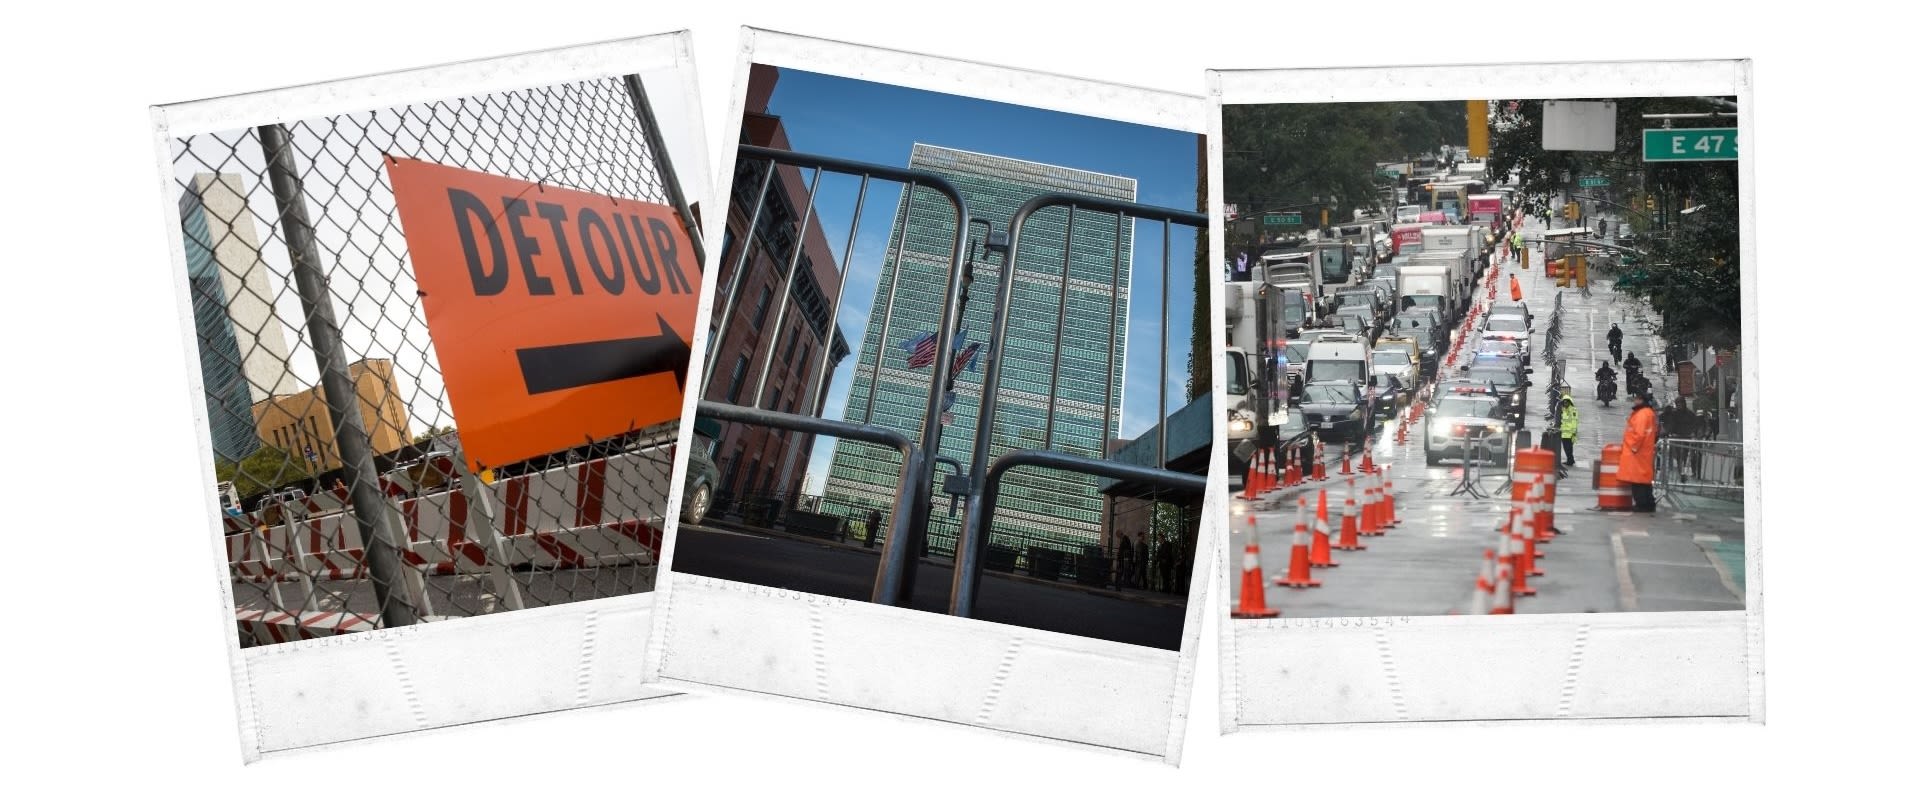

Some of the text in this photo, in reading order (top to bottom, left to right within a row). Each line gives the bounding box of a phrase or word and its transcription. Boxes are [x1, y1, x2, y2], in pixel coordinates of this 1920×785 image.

[1672, 136, 1686, 154] E
[1694, 135, 1725, 153] 47
[447, 187, 693, 296] DETOUR
